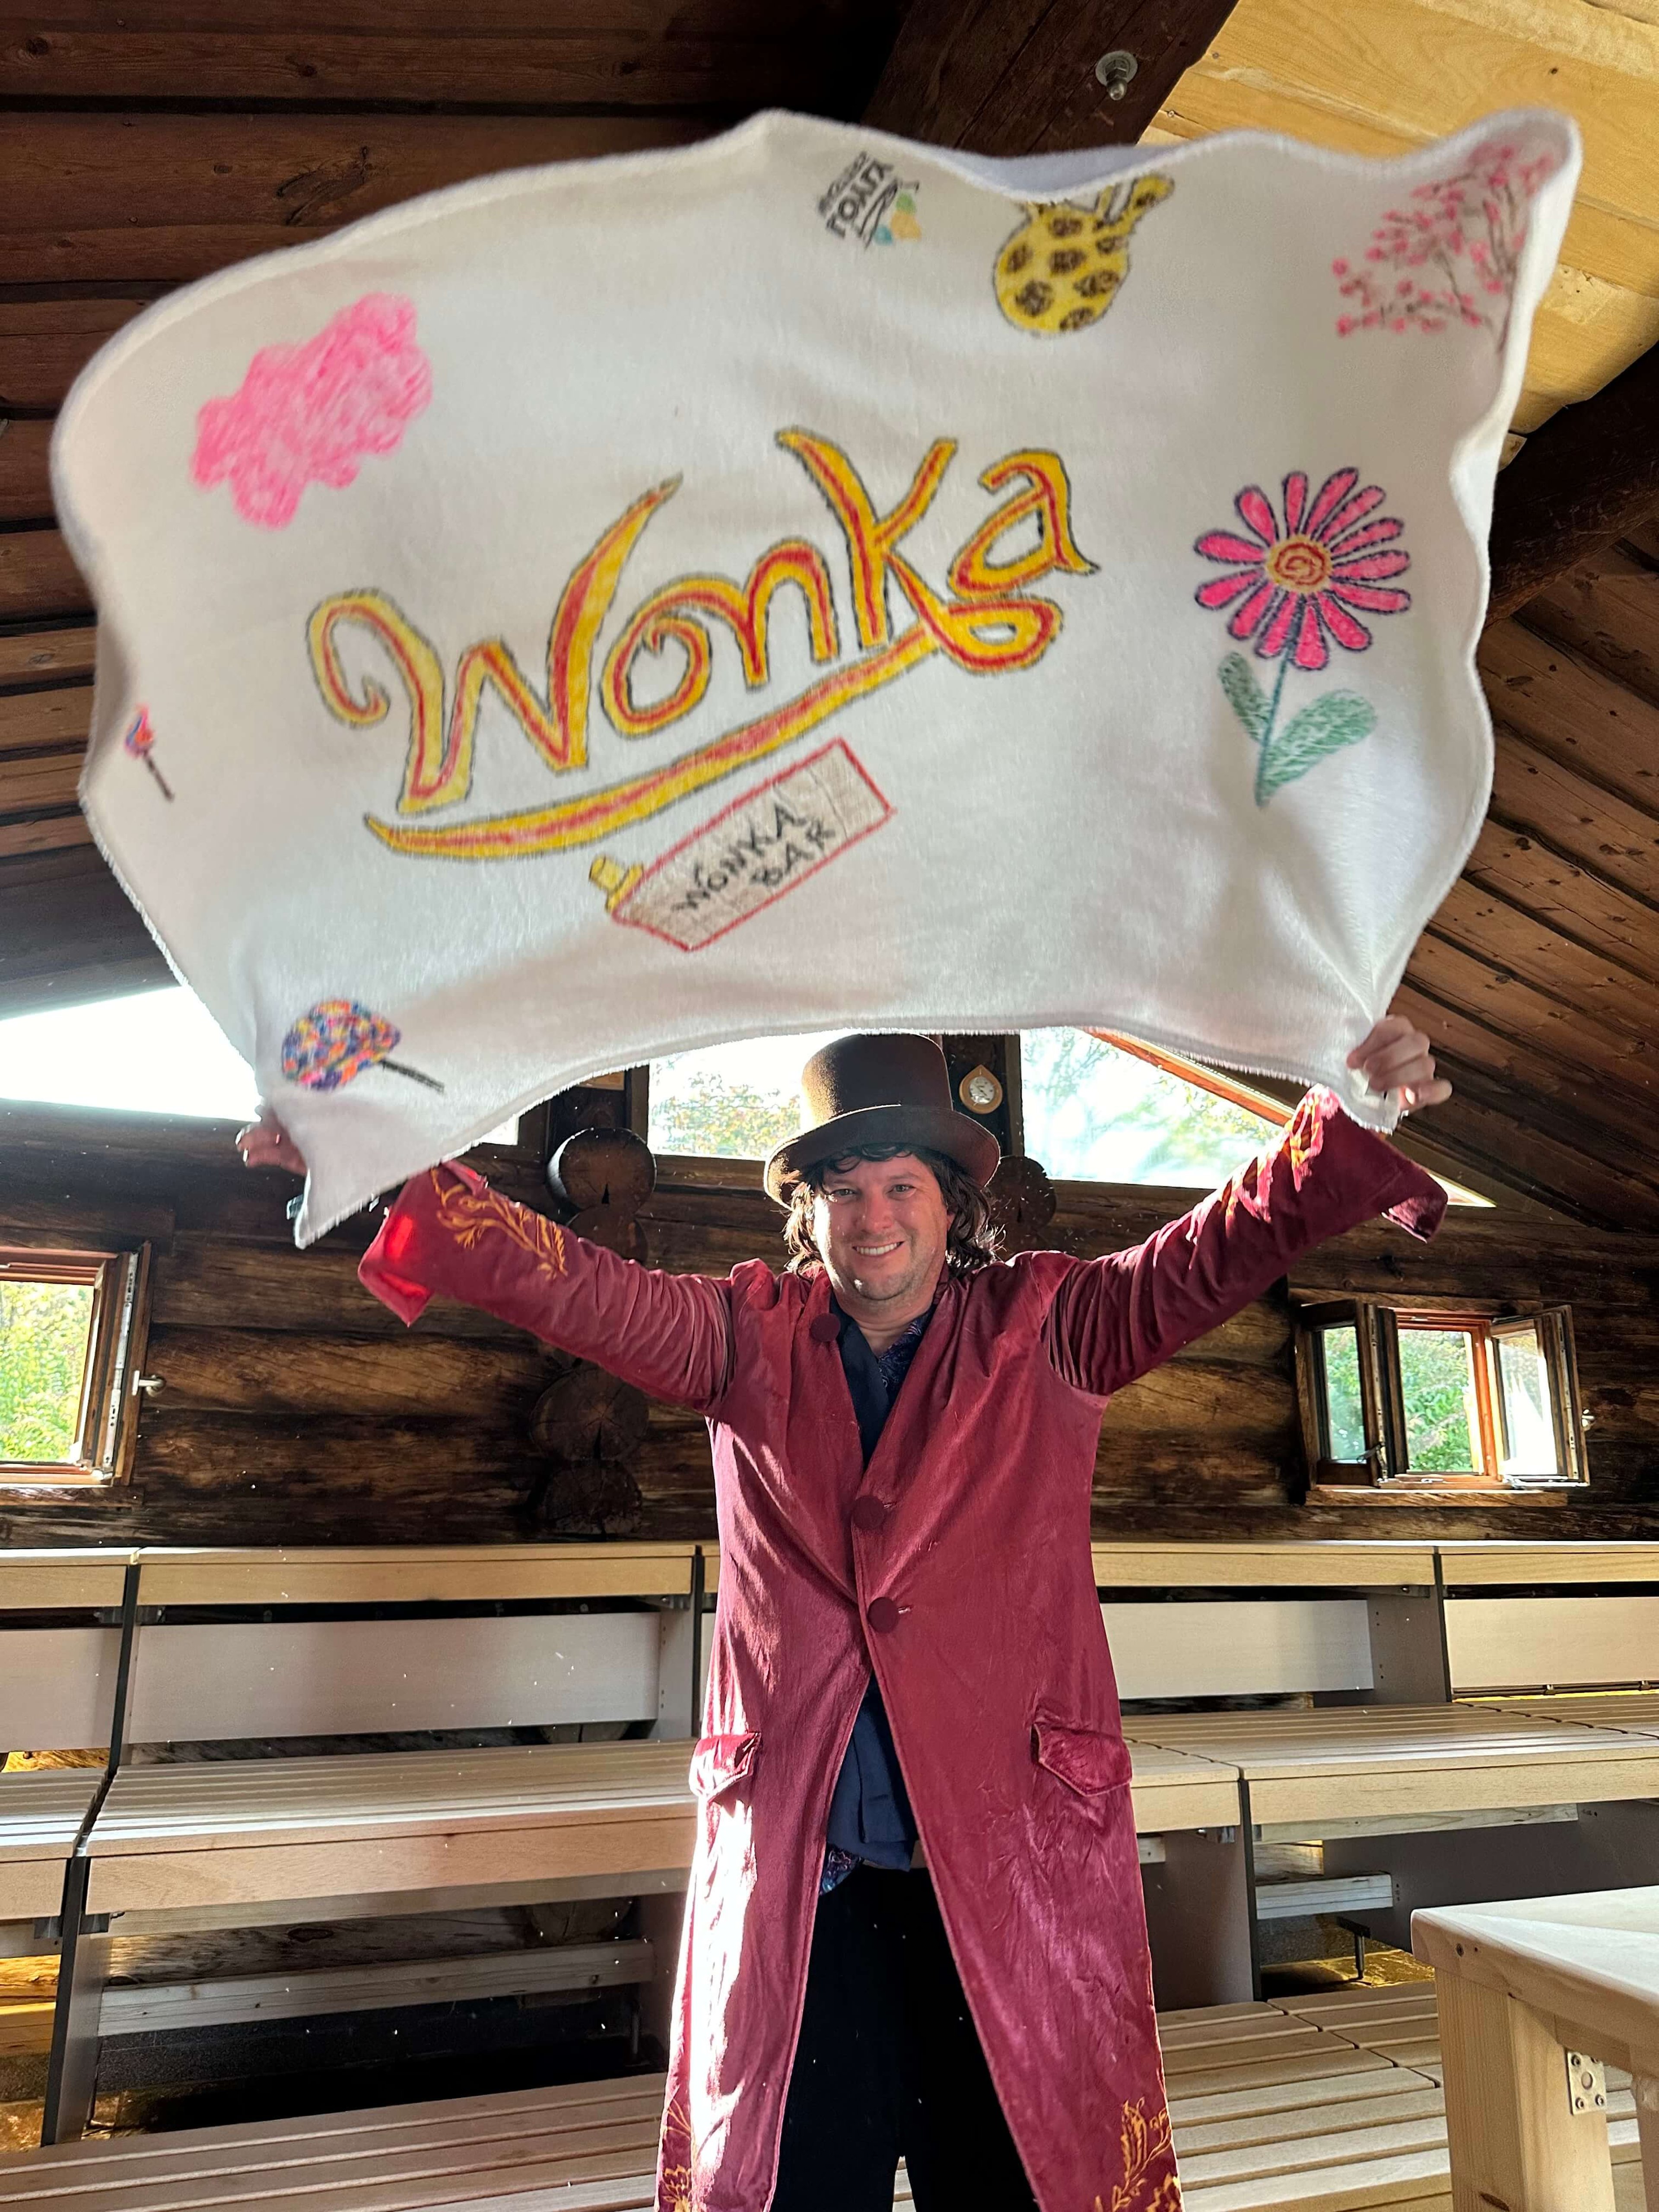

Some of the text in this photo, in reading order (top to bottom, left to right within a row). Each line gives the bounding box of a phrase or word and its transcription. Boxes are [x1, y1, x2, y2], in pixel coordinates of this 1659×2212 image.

[305, 426, 1099, 817] Wonka
[671, 803, 807, 912] WONKA
[750, 819, 836, 887] BAR
